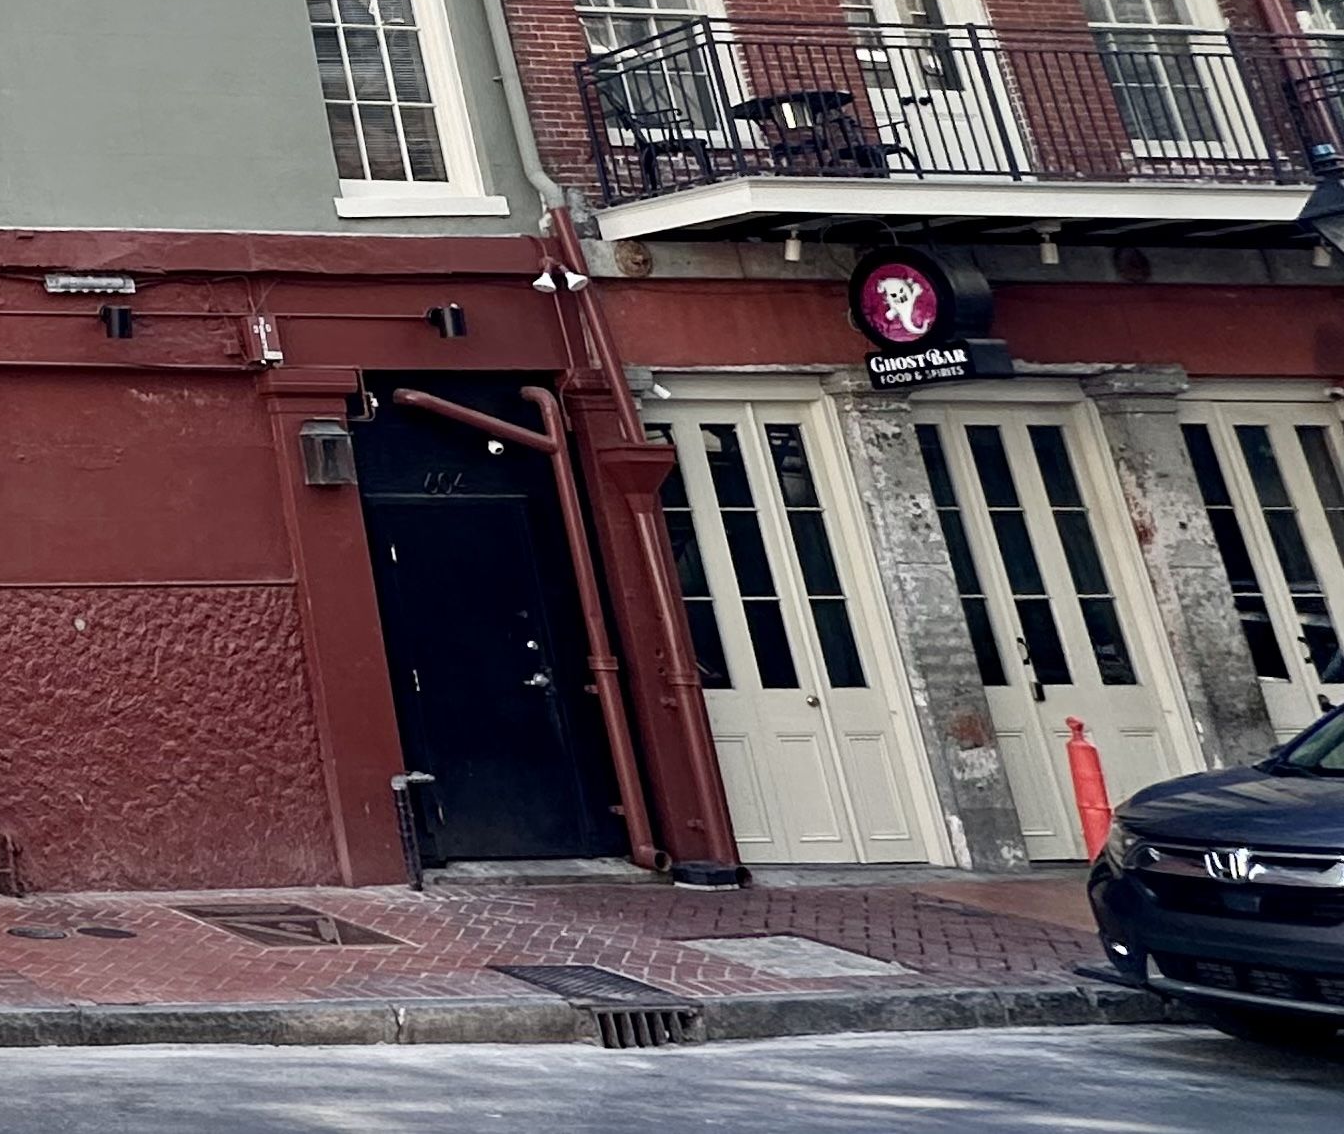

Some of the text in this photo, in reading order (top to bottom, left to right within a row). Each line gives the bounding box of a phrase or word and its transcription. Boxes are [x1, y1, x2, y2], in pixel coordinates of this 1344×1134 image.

[880, 366, 965, 384] FOOD & SPIRITS
